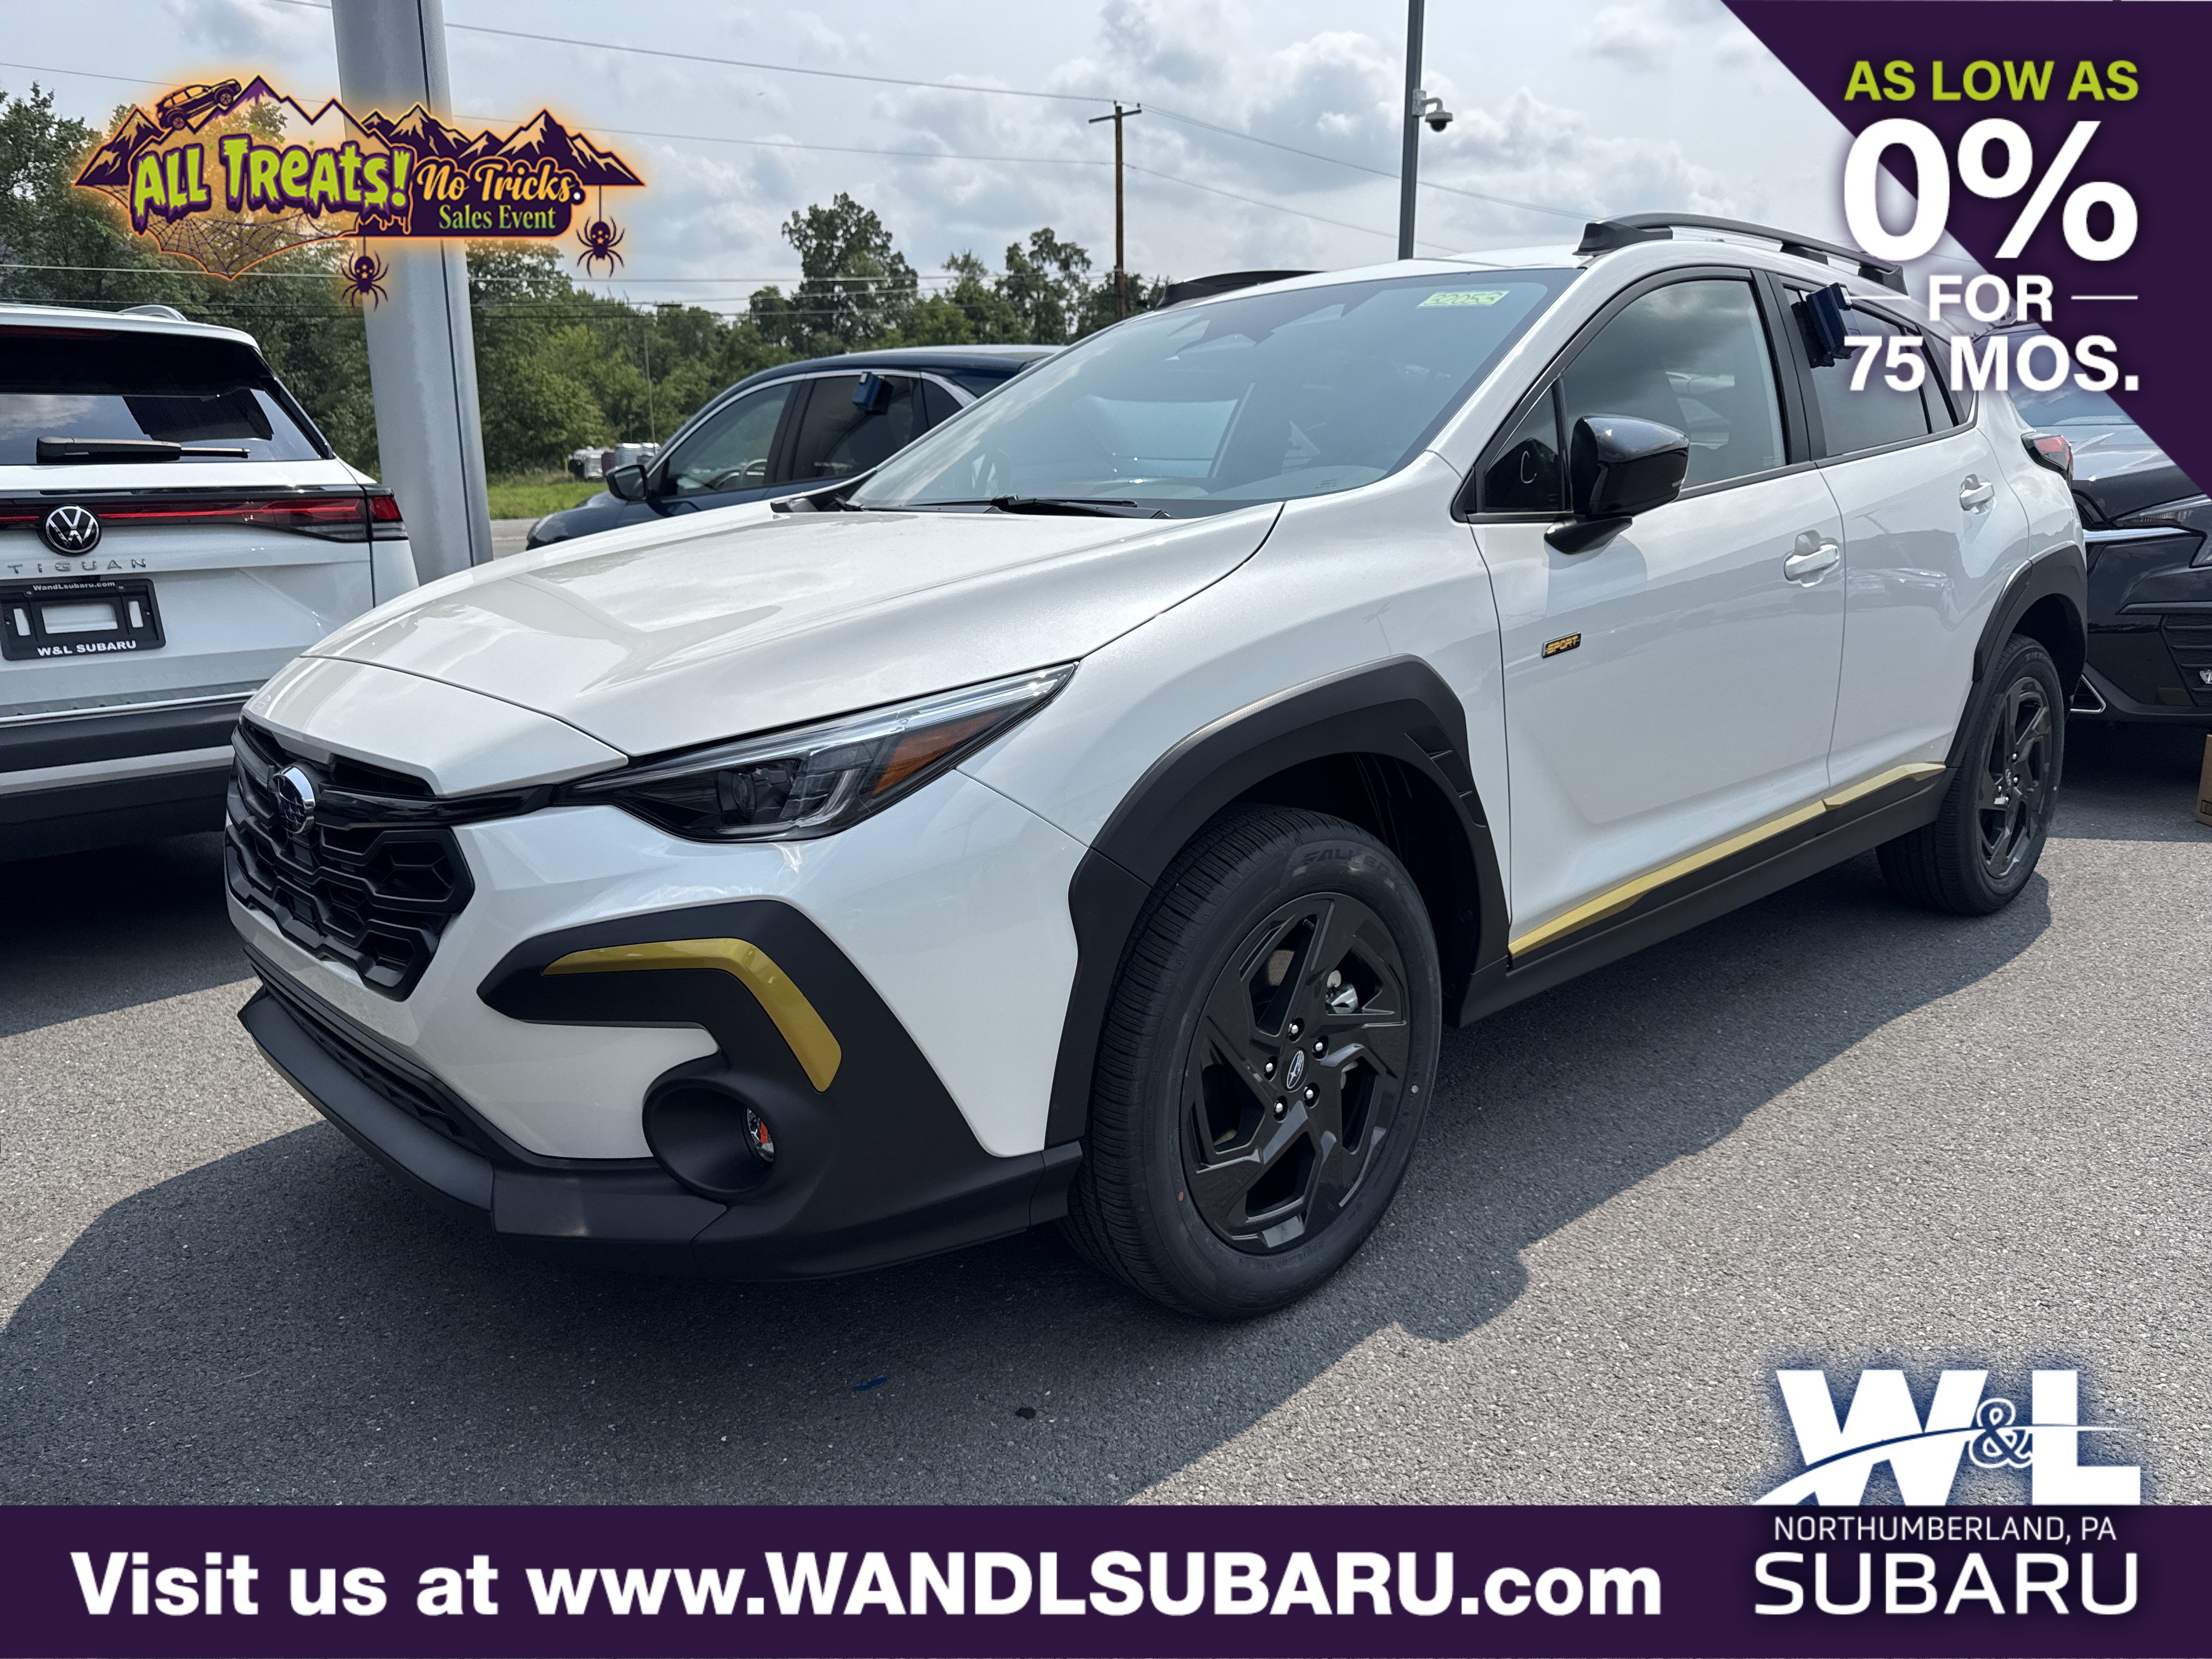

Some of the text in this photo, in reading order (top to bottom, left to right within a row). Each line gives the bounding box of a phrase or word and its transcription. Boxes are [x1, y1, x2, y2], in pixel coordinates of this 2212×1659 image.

[7, 558, 146, 574] TIGUAN
[37, 640, 137, 656] W&L SUBARU
[1545, 635, 1579, 654] SPORT
